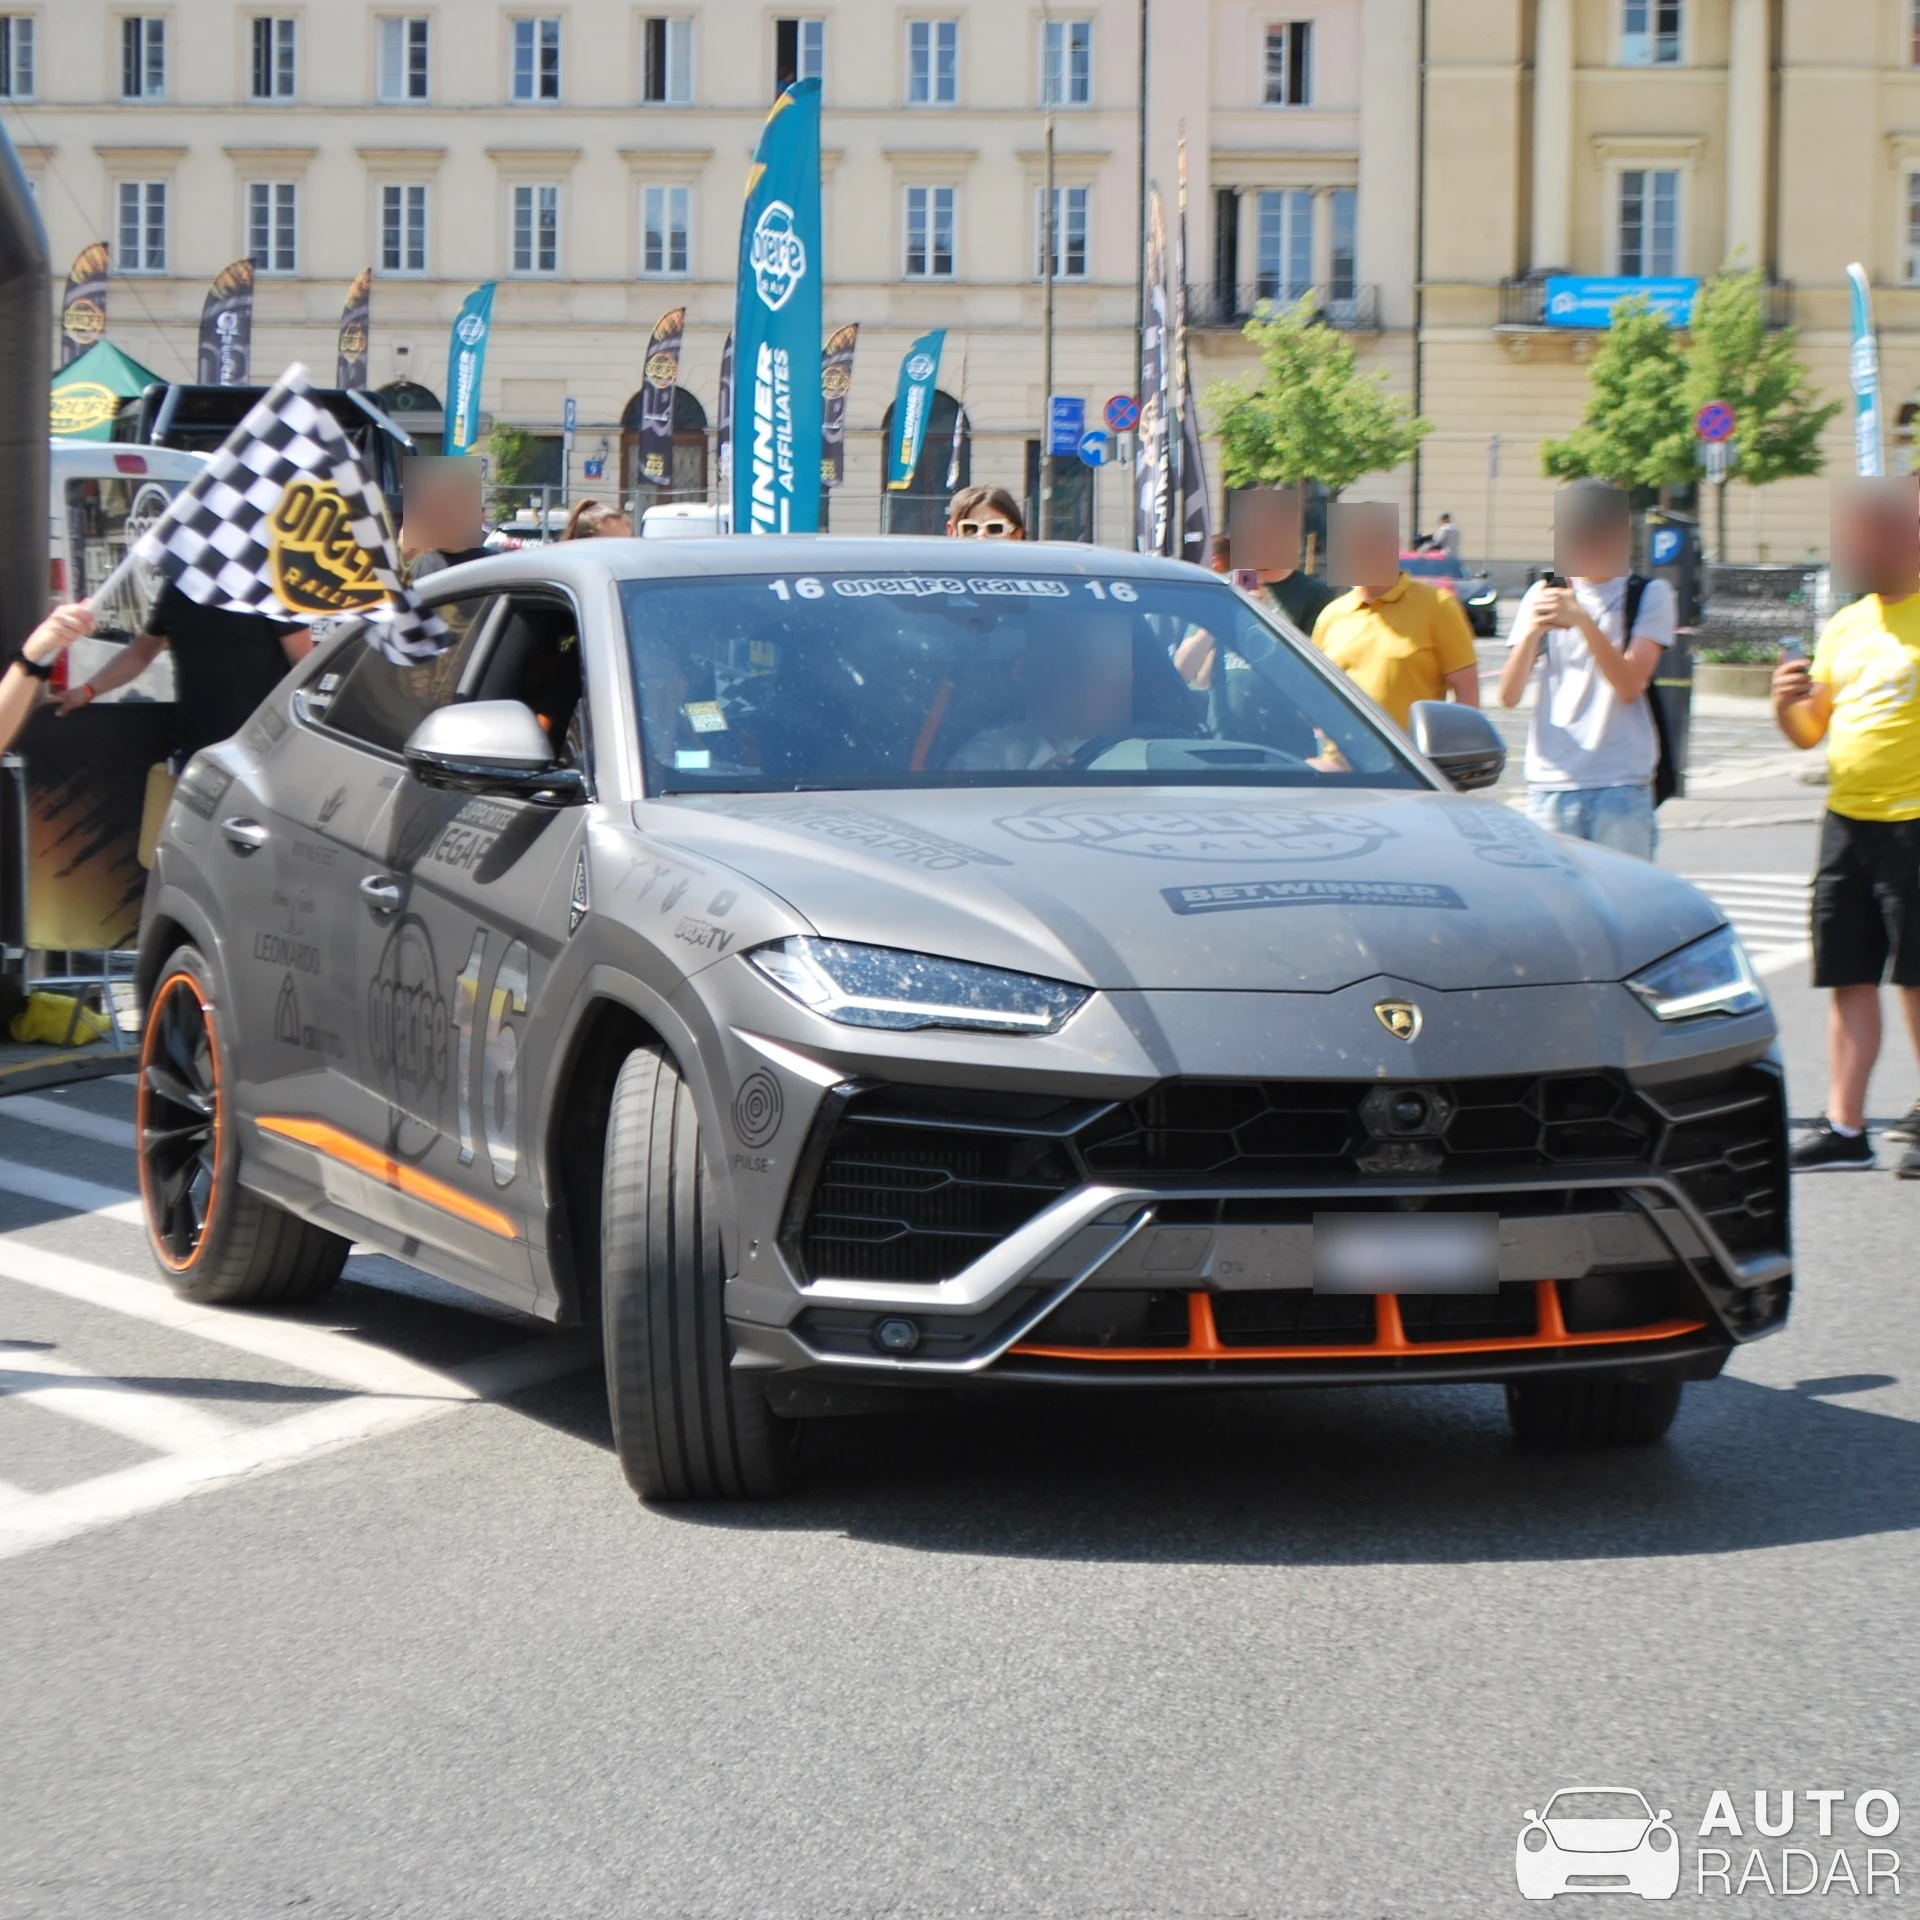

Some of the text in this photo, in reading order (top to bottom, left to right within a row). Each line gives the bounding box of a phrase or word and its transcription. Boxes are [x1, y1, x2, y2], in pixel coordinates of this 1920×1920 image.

[773, 348, 794, 493] AFFILIATES
[1654, 531, 1677, 559] P
[283, 567, 361, 607] RALLY
[768, 578, 825, 600] 16
[1084, 580, 1139, 602] 16
[1146, 841, 1334, 853] RALLY
[1181, 883, 1438, 902] BETWINNER
[254, 931, 321, 976] LEONARDO
[451, 927, 530, 1189] 16
[734, 1154, 769, 1173] PULSE
